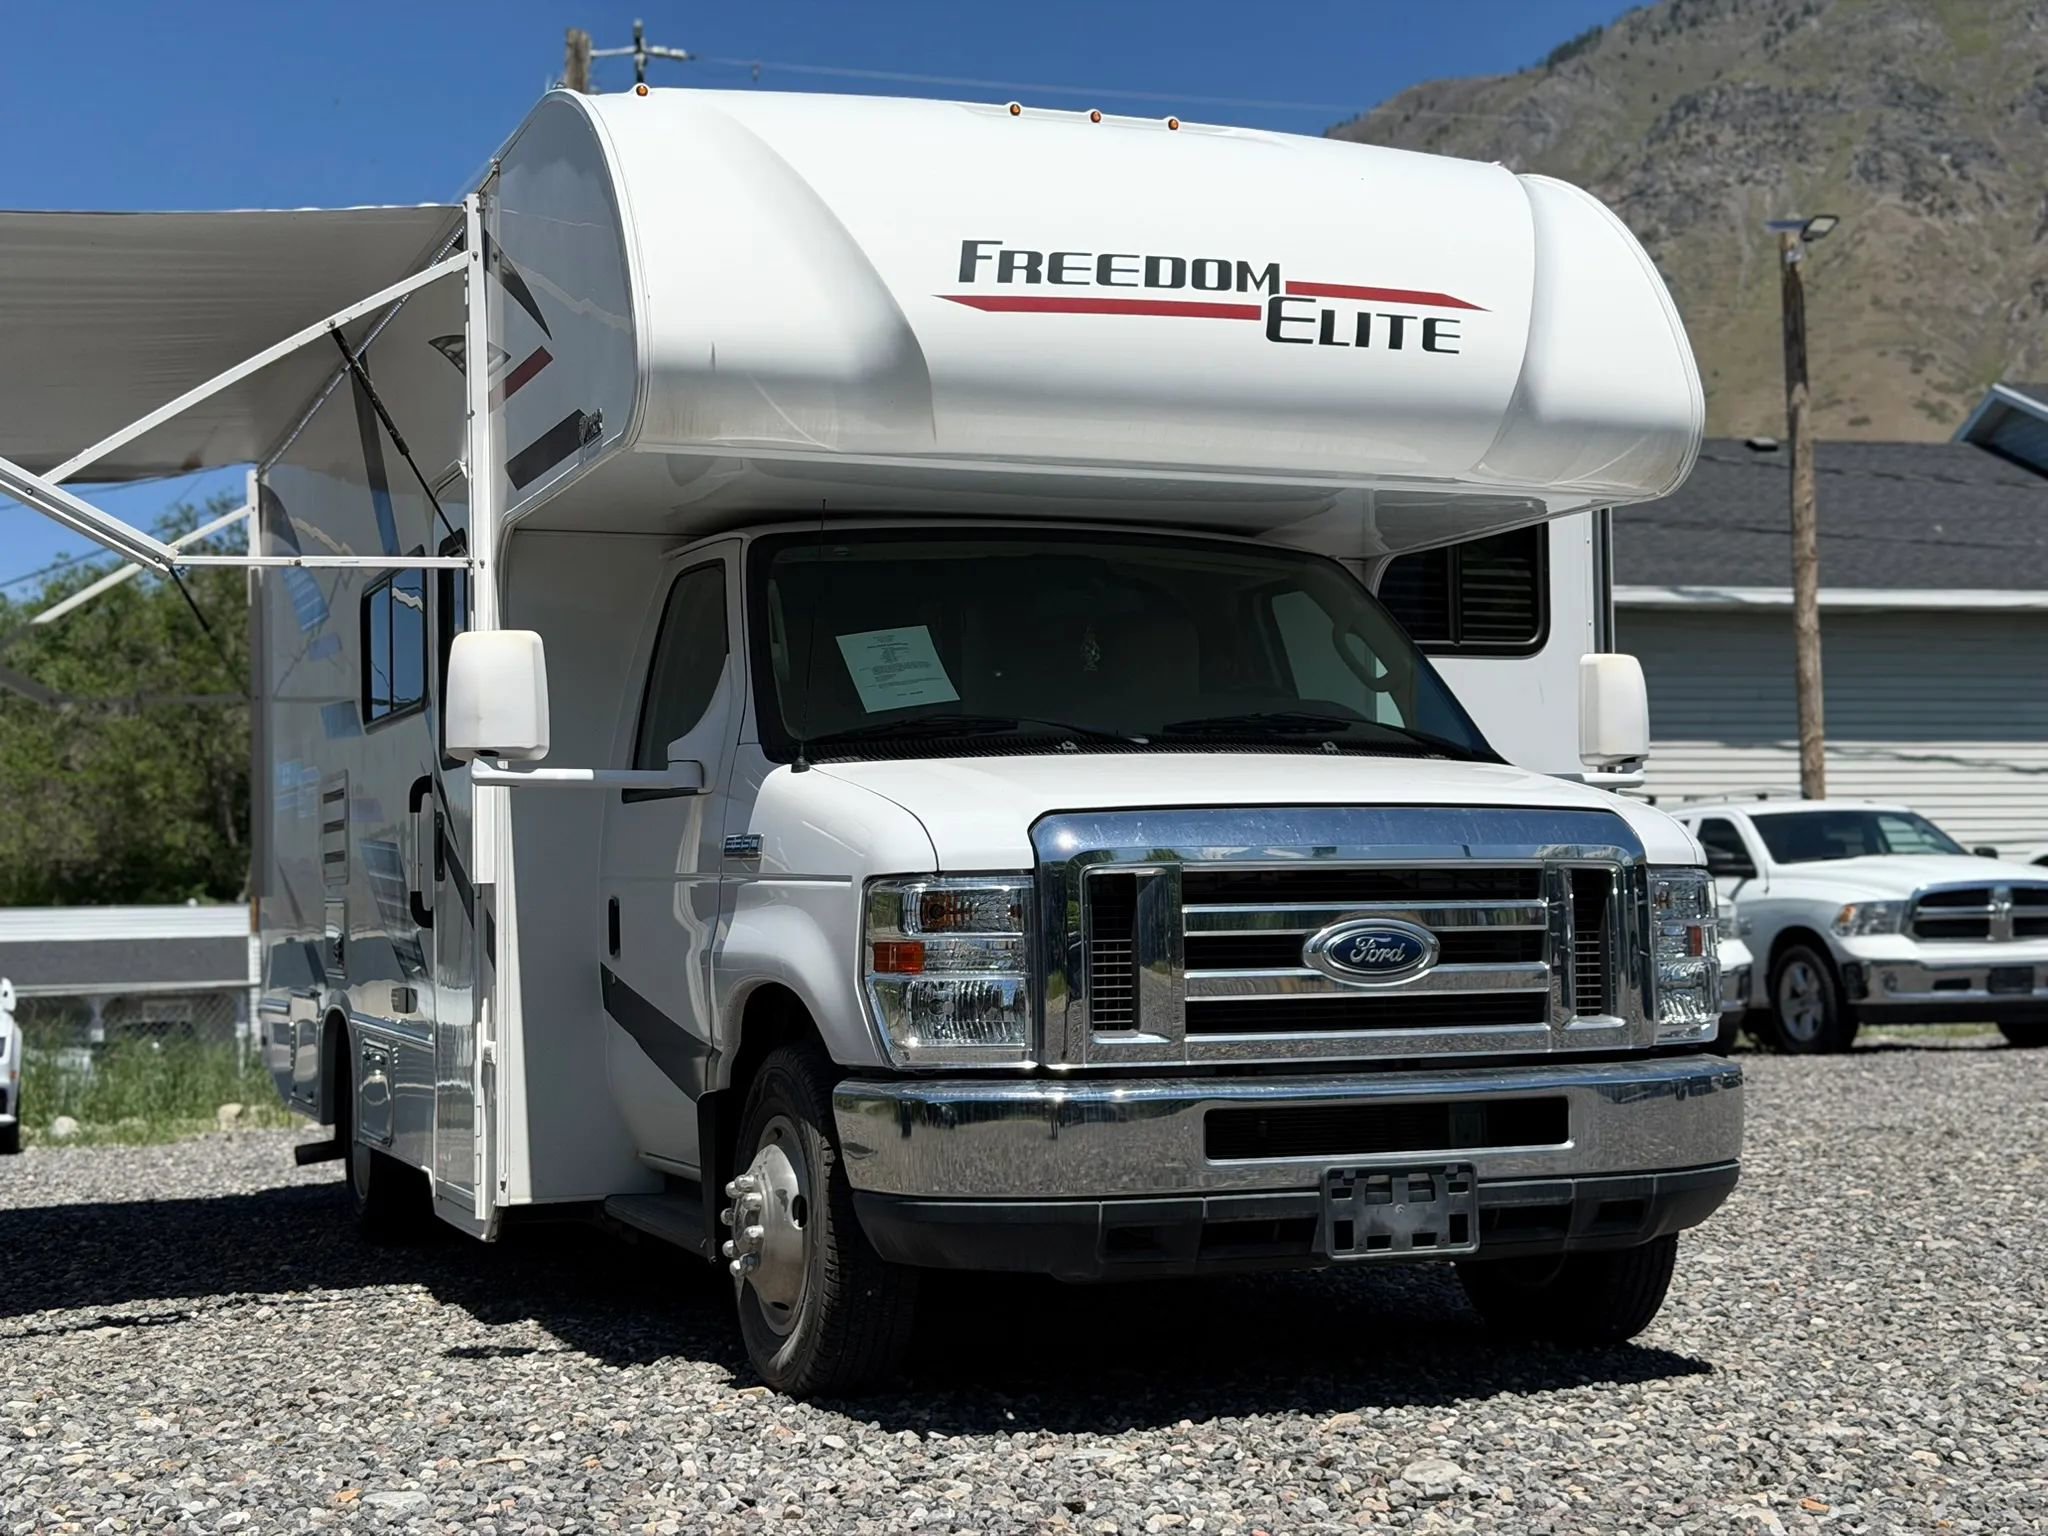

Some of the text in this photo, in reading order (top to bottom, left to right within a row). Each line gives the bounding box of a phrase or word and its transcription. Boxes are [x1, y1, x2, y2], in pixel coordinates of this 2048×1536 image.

[958, 240, 1280, 295] FREEDOM
[1266, 296, 1461, 354] ELITE
[1350, 936, 1406, 963] Ford
